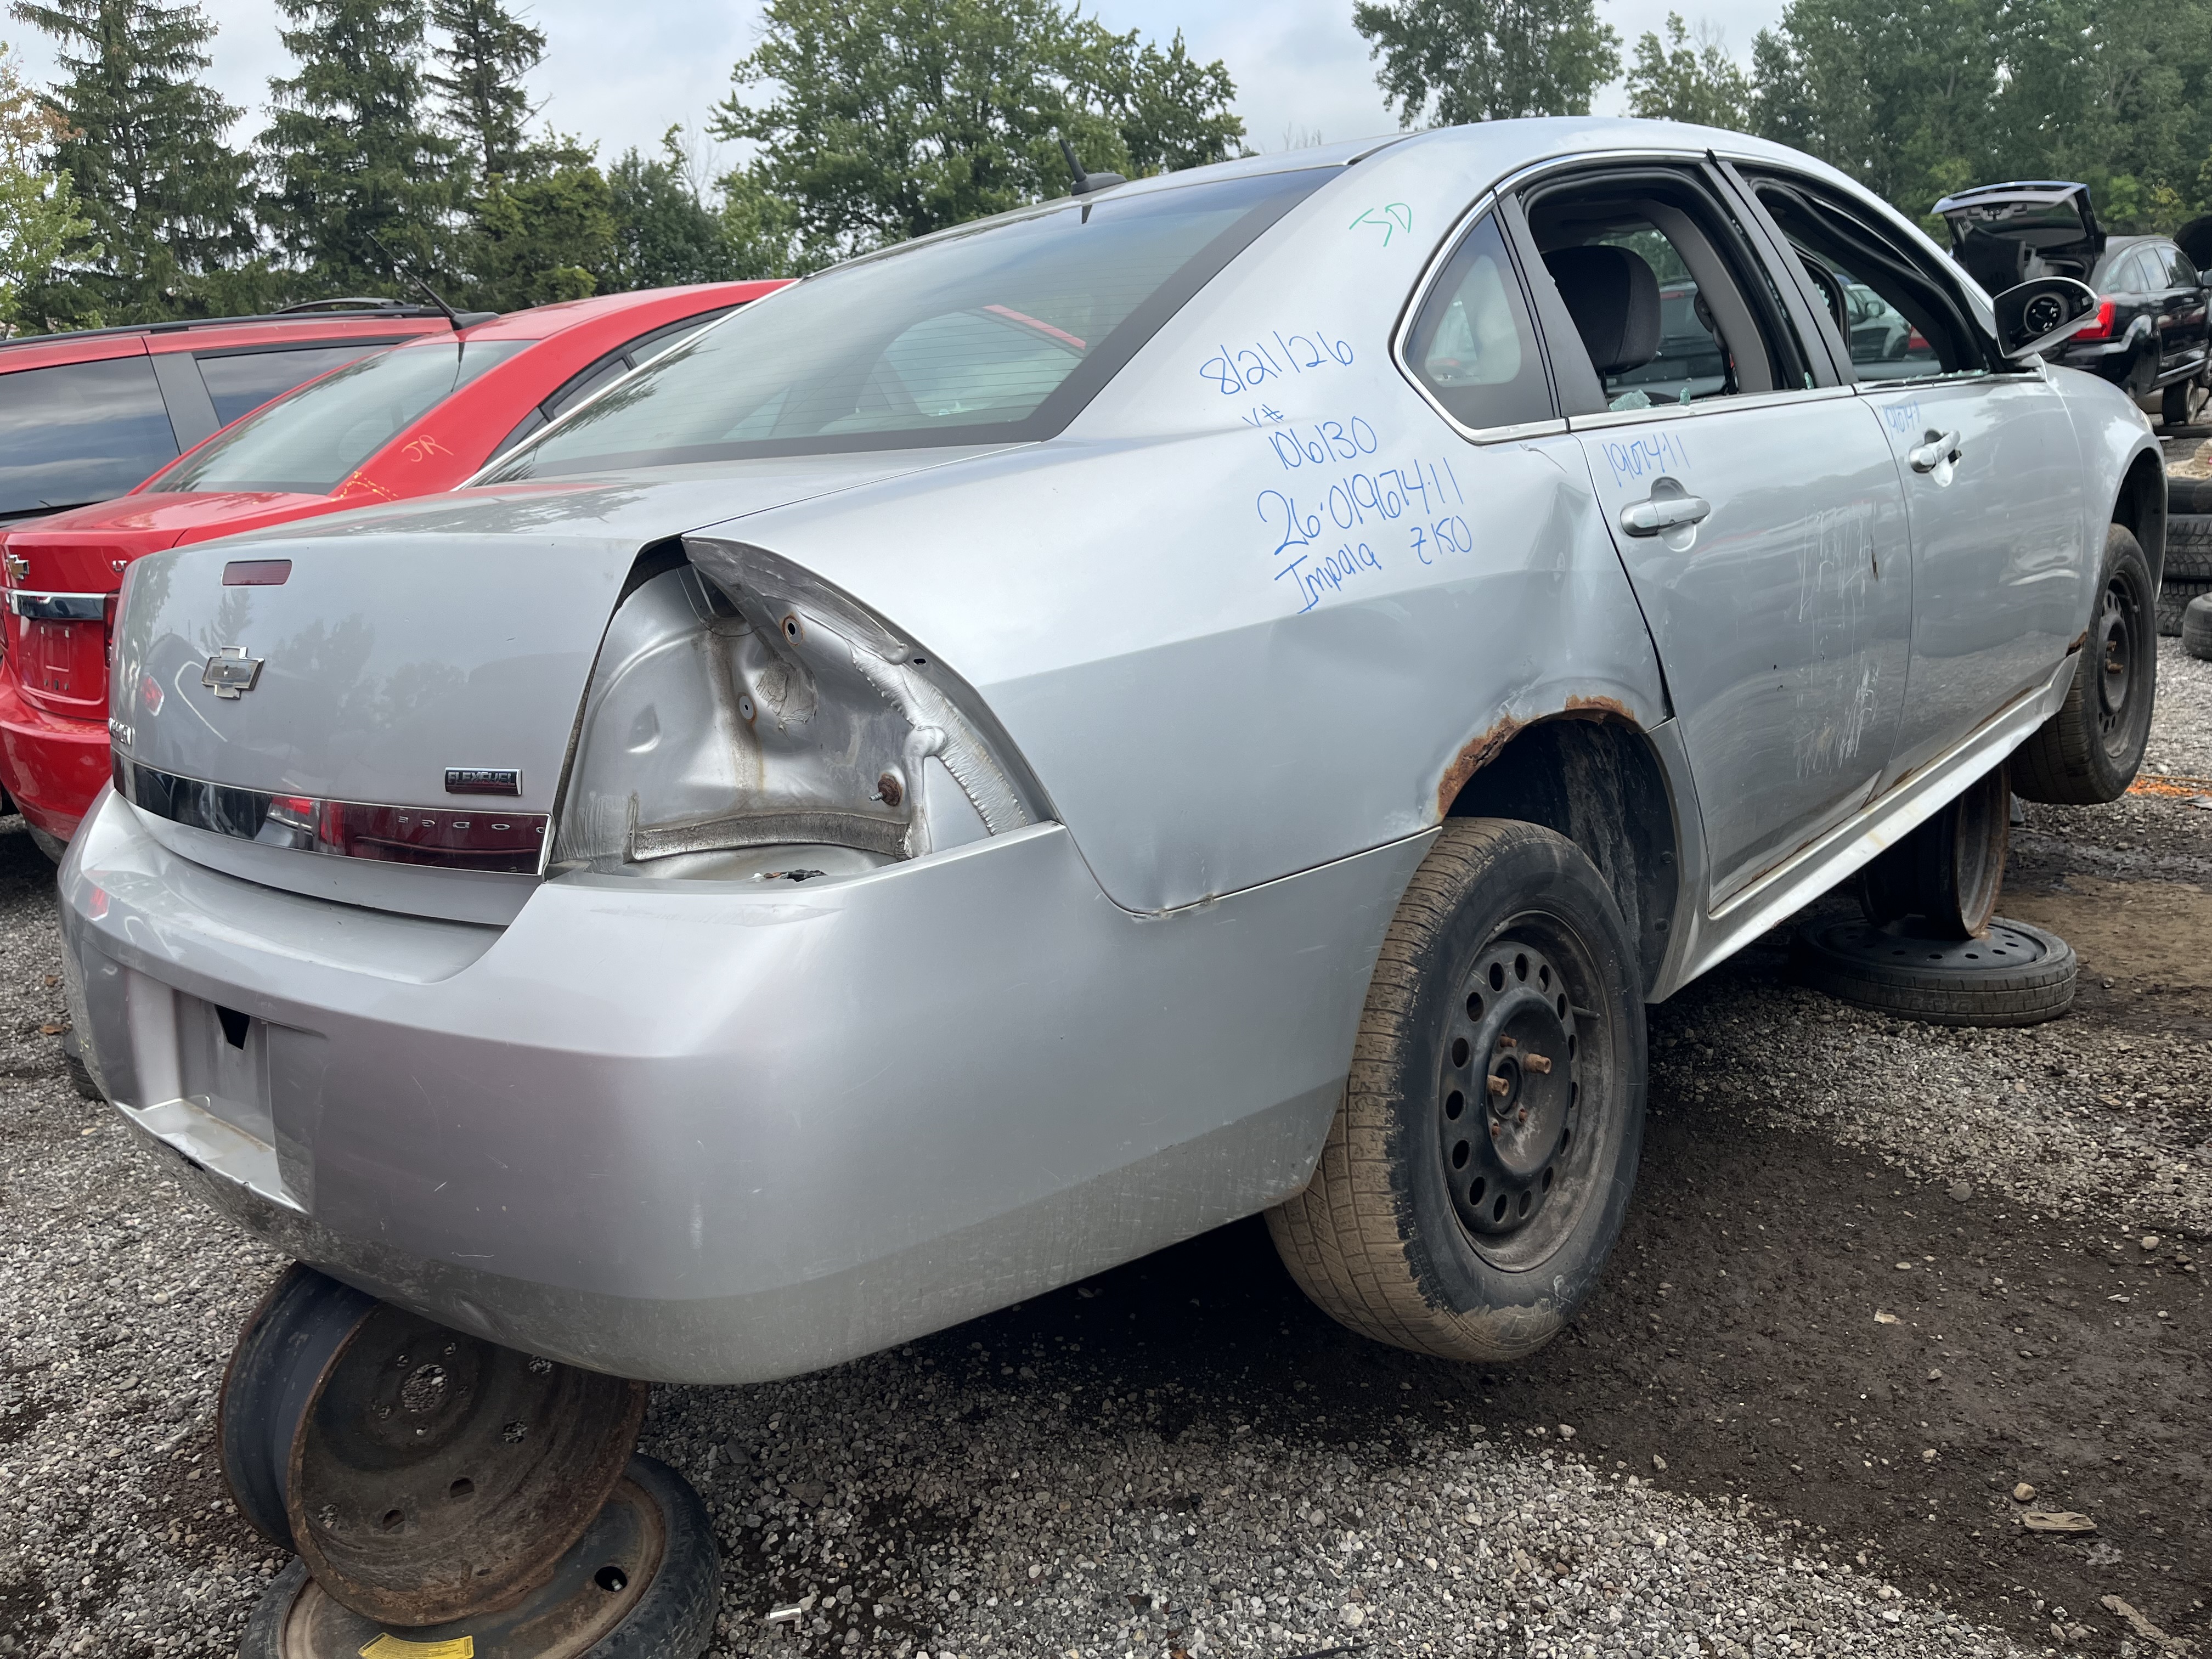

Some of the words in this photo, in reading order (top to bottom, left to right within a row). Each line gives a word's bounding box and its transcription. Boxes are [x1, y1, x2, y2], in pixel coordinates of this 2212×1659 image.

[1199, 330, 1353, 394] 8/21/26
[1268, 415, 1377, 470] 106130
[112, 560, 127, 572] LT
[1274, 543, 1382, 614] Impala
[447, 771, 516, 786] FLEXFUEL
